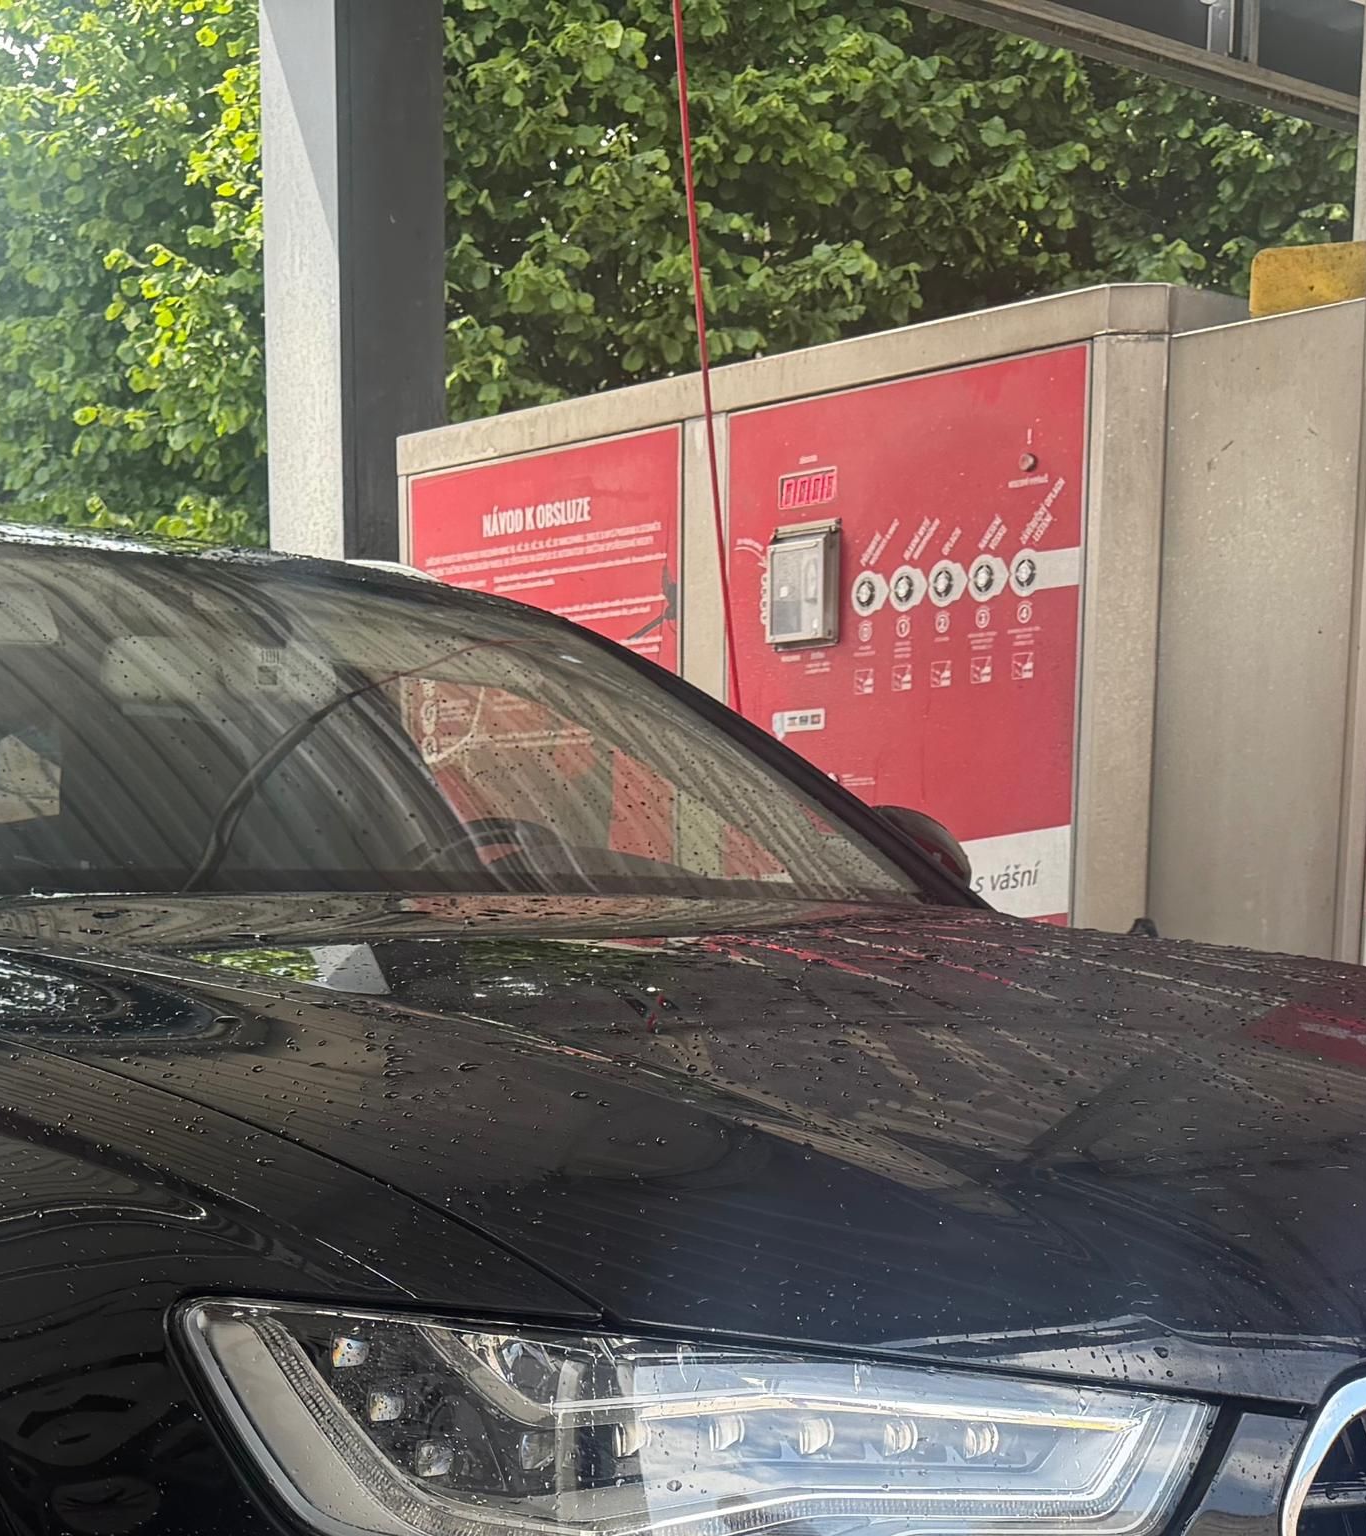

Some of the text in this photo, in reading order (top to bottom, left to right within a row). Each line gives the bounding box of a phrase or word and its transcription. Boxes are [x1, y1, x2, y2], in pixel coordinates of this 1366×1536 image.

[482, 497, 592, 538] NÁVOD K OBSLUZE
[975, 860, 1041, 893] s vášní
